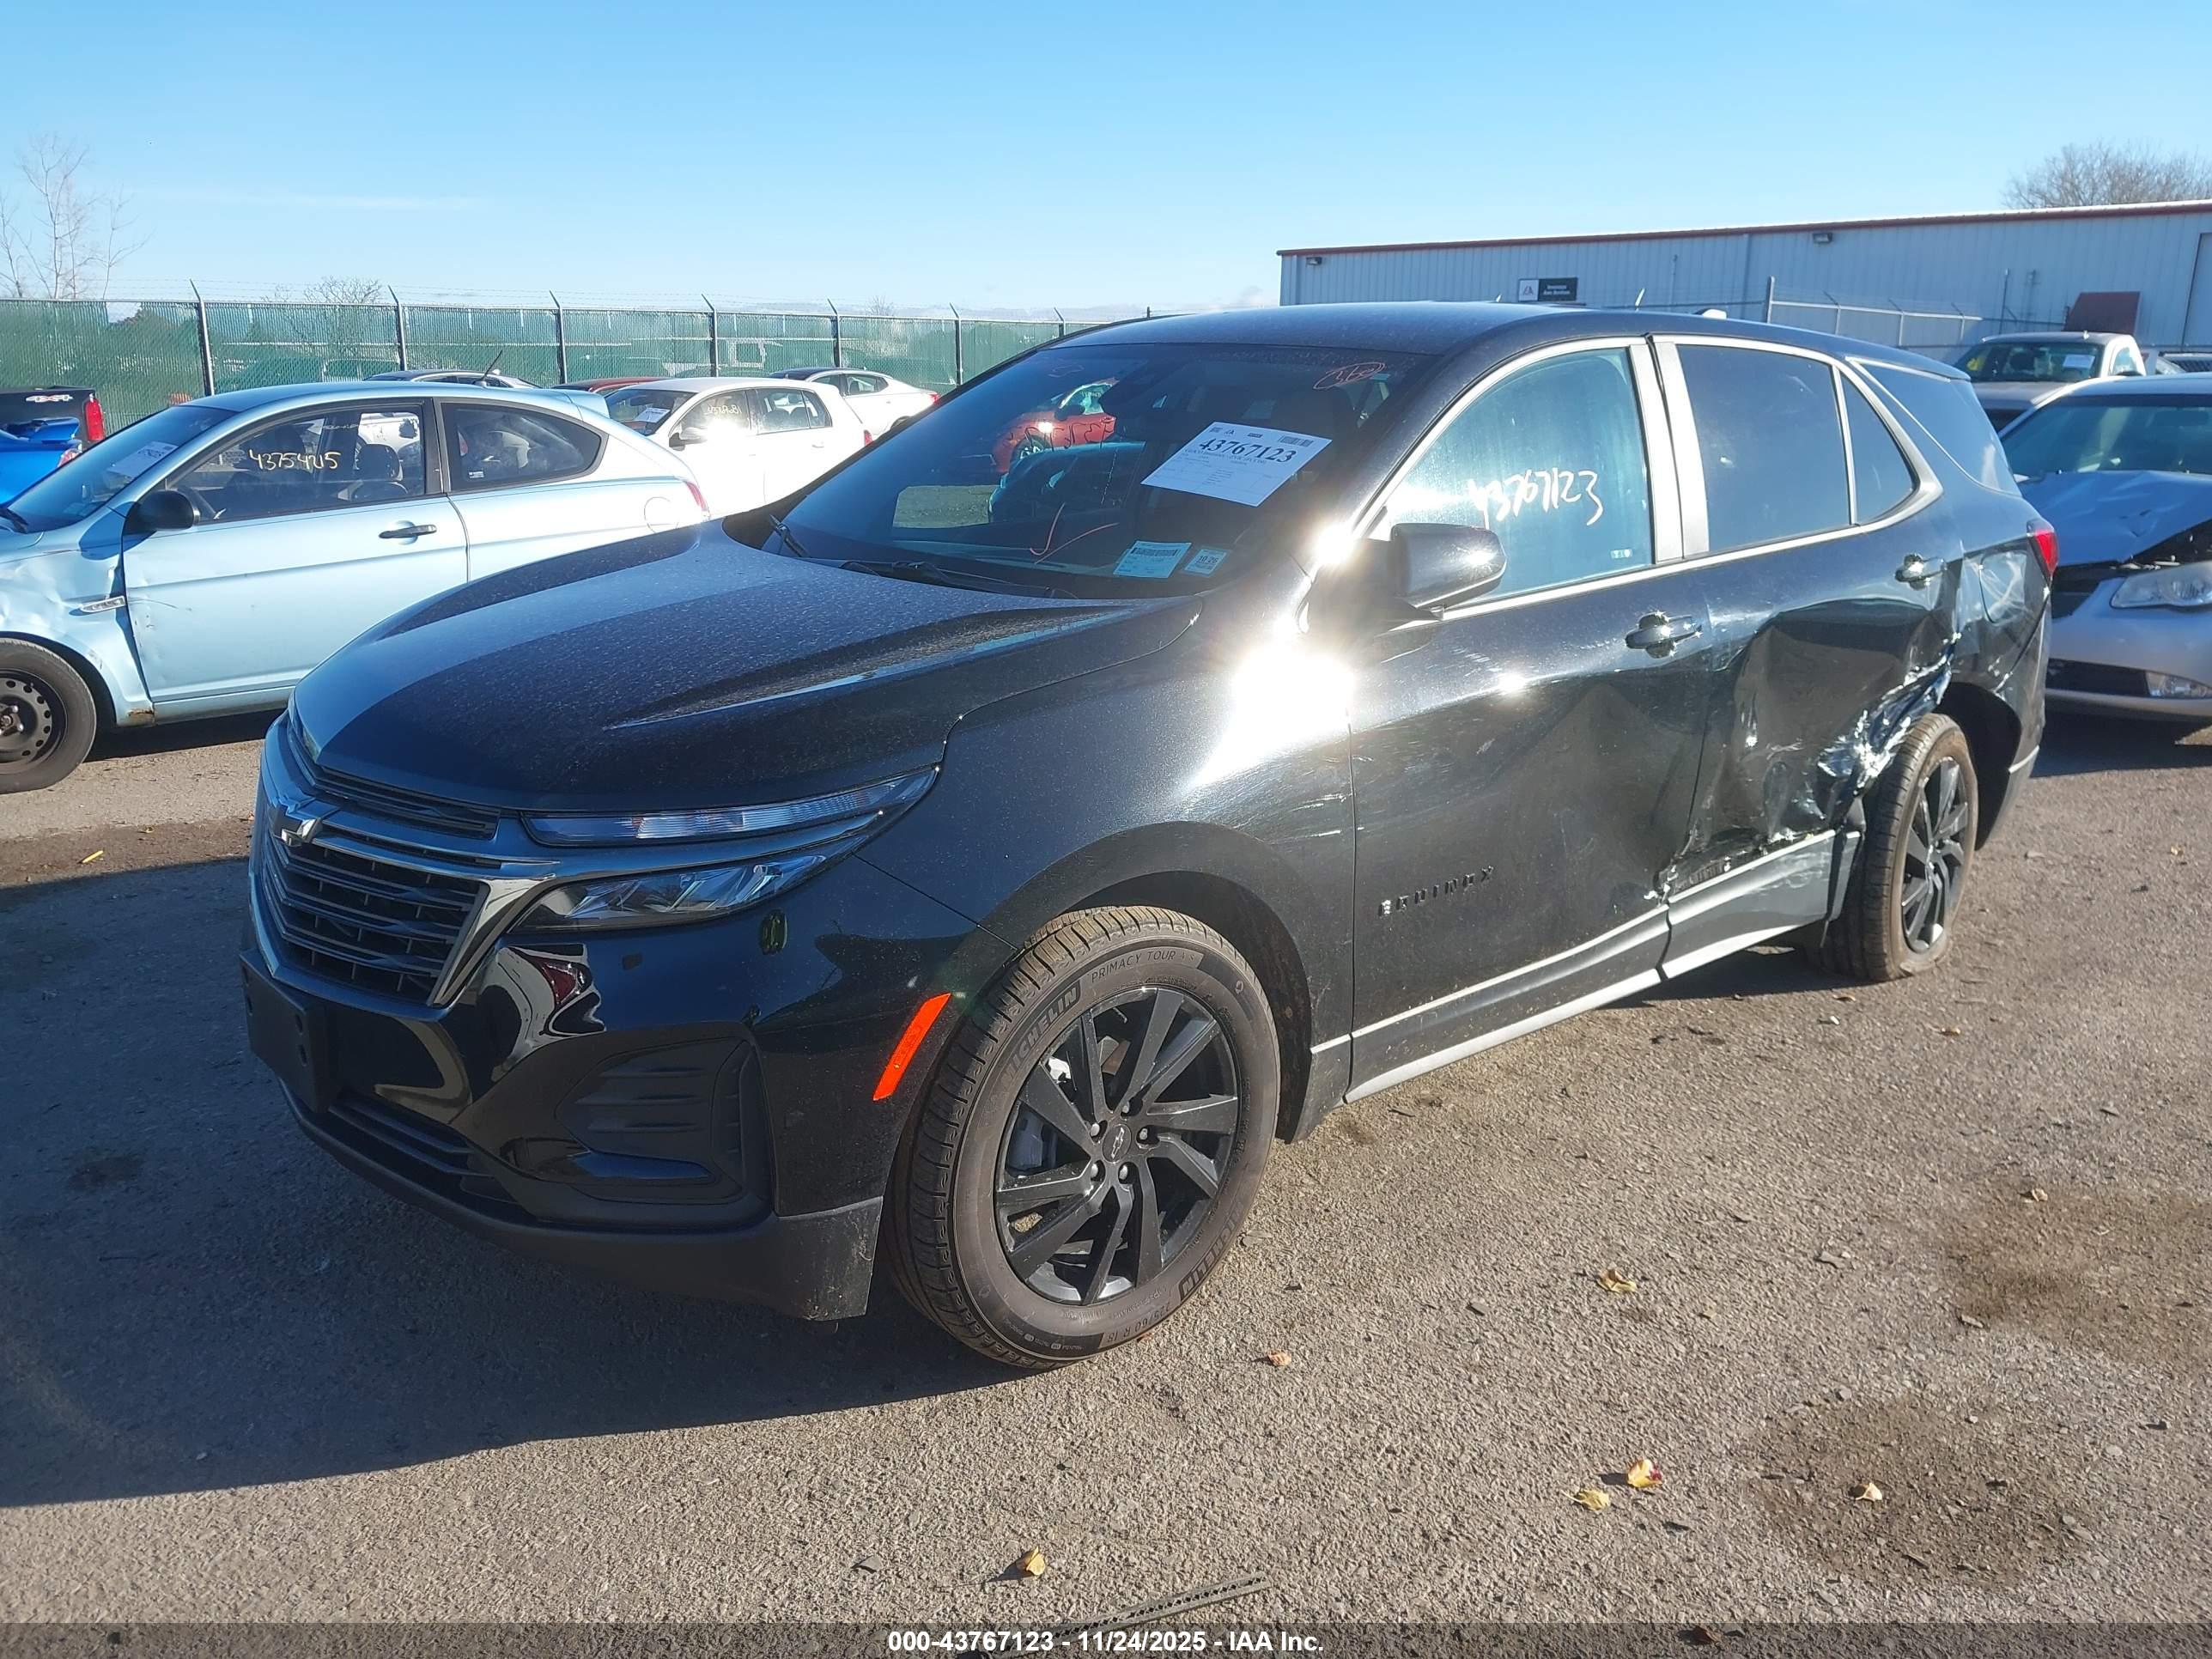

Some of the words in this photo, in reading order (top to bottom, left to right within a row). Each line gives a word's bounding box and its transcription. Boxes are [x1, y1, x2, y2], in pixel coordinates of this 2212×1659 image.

[1199, 438, 1297, 463] 43767123
[1467, 467, 1603, 530] 43767123
[1091, 952, 1142, 983] PRIMACY
[1147, 950, 1176, 961] TOUR
[998, 987, 1077, 1085] MICHELIN
